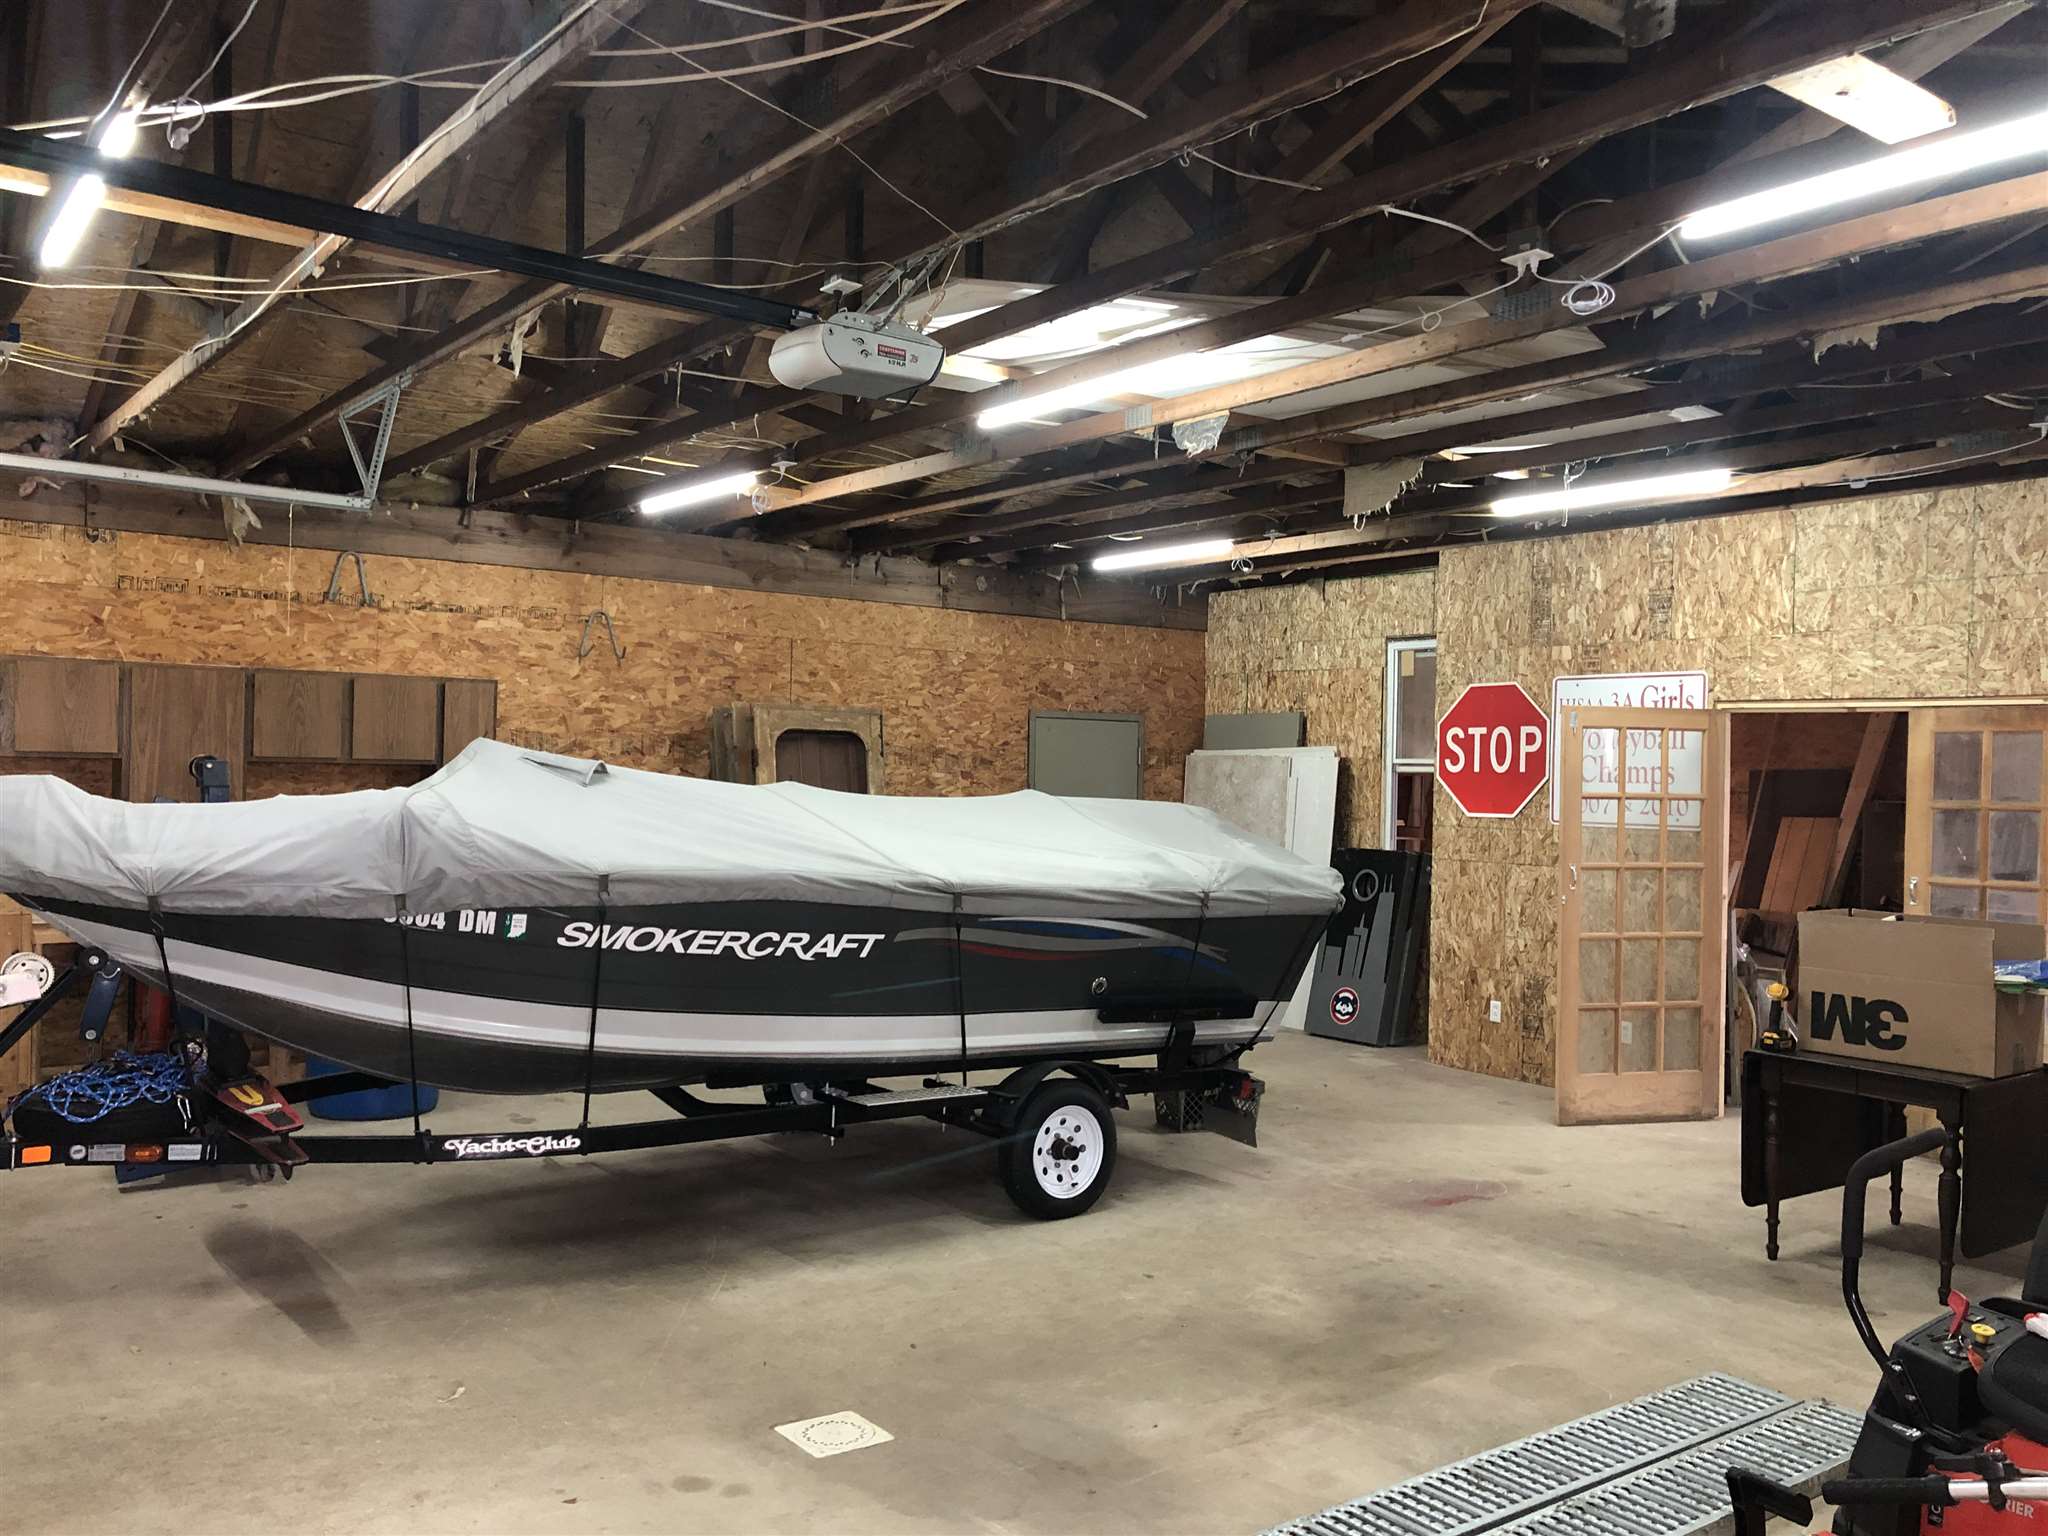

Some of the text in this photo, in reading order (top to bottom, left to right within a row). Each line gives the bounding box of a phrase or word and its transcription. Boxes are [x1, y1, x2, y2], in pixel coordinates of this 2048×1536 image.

[1641, 683, 1694, 709] Girls
[1444, 725, 1542, 773] STOP
[1583, 729, 1687, 756] ollybll
[458, 909, 497, 935] DM
[557, 922, 885, 960] SMOKERCRAFT
[1811, 991, 1909, 1050] 3M
